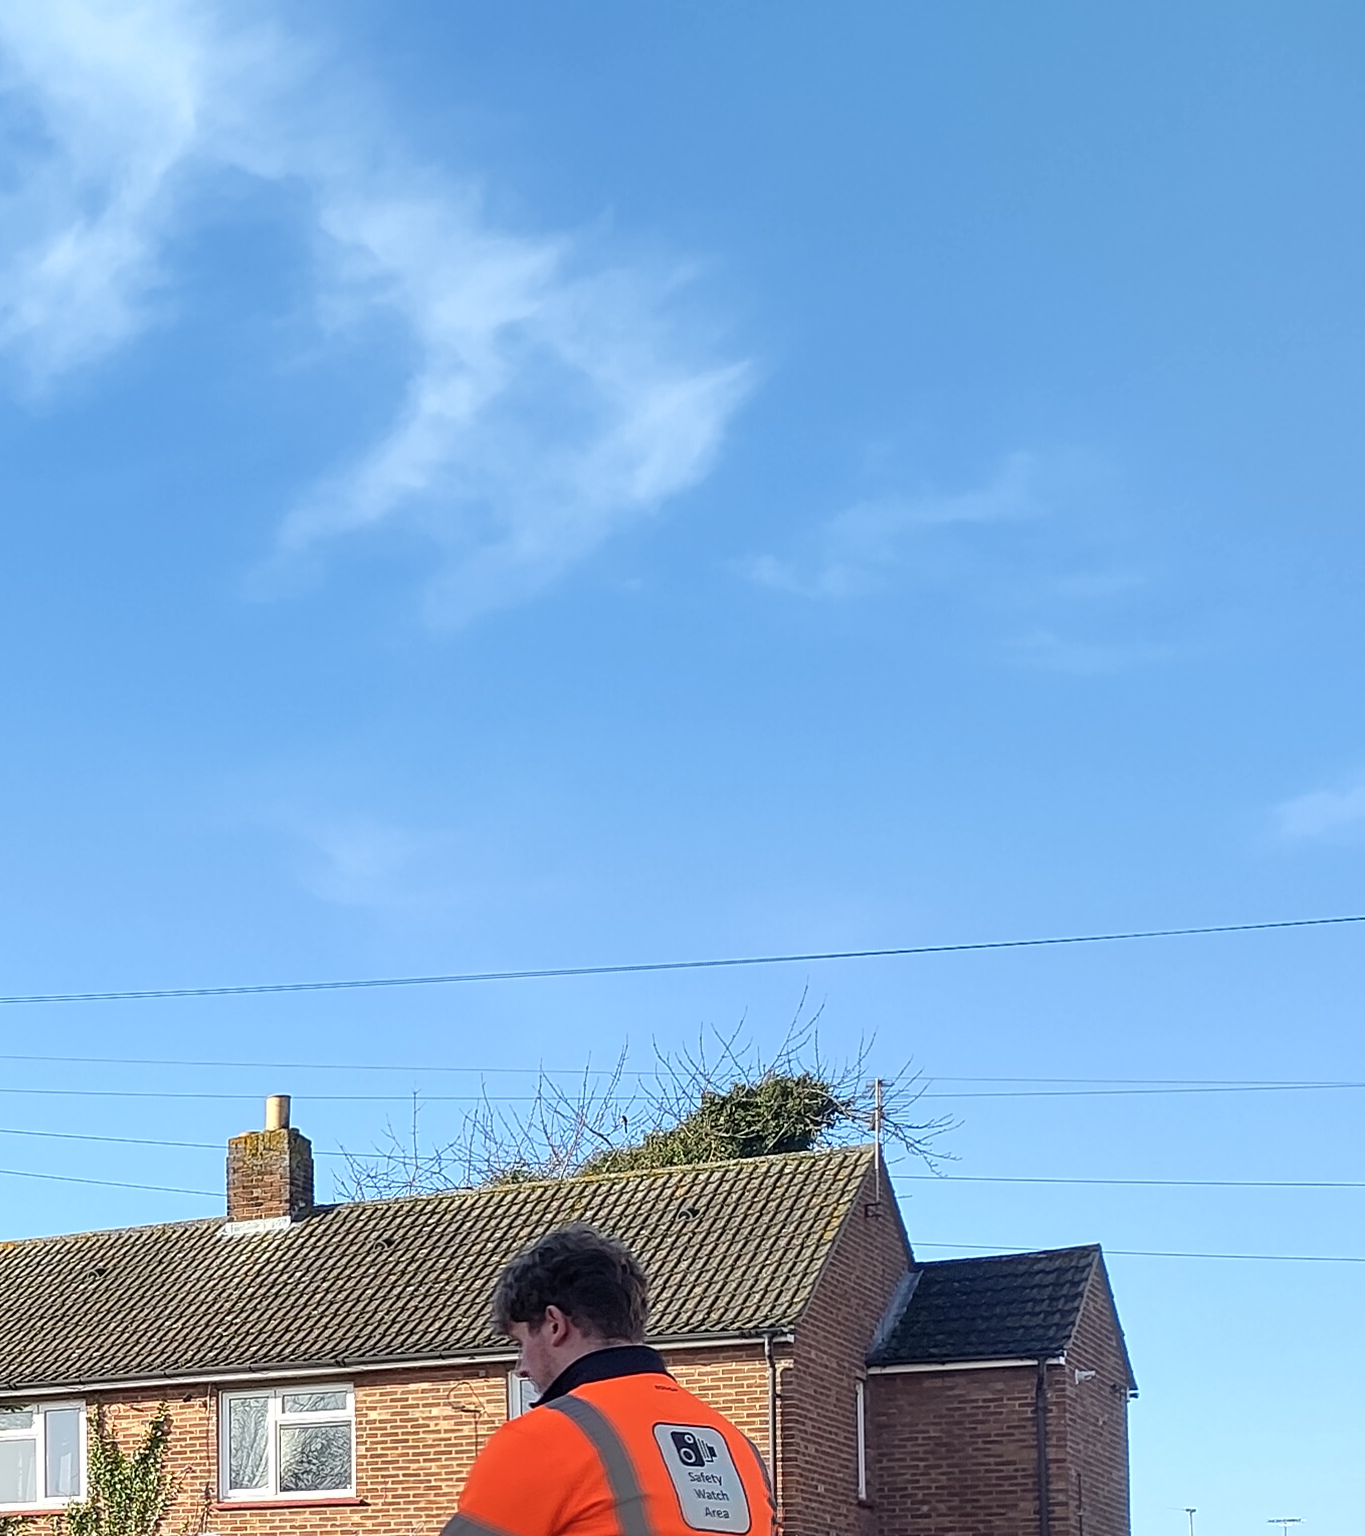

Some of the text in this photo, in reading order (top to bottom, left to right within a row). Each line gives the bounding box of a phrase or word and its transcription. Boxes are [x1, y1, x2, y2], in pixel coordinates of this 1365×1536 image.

[688, 1472, 723, 1486] Safety
[694, 1489, 730, 1502] Watch
[704, 1506, 730, 1519] Area
